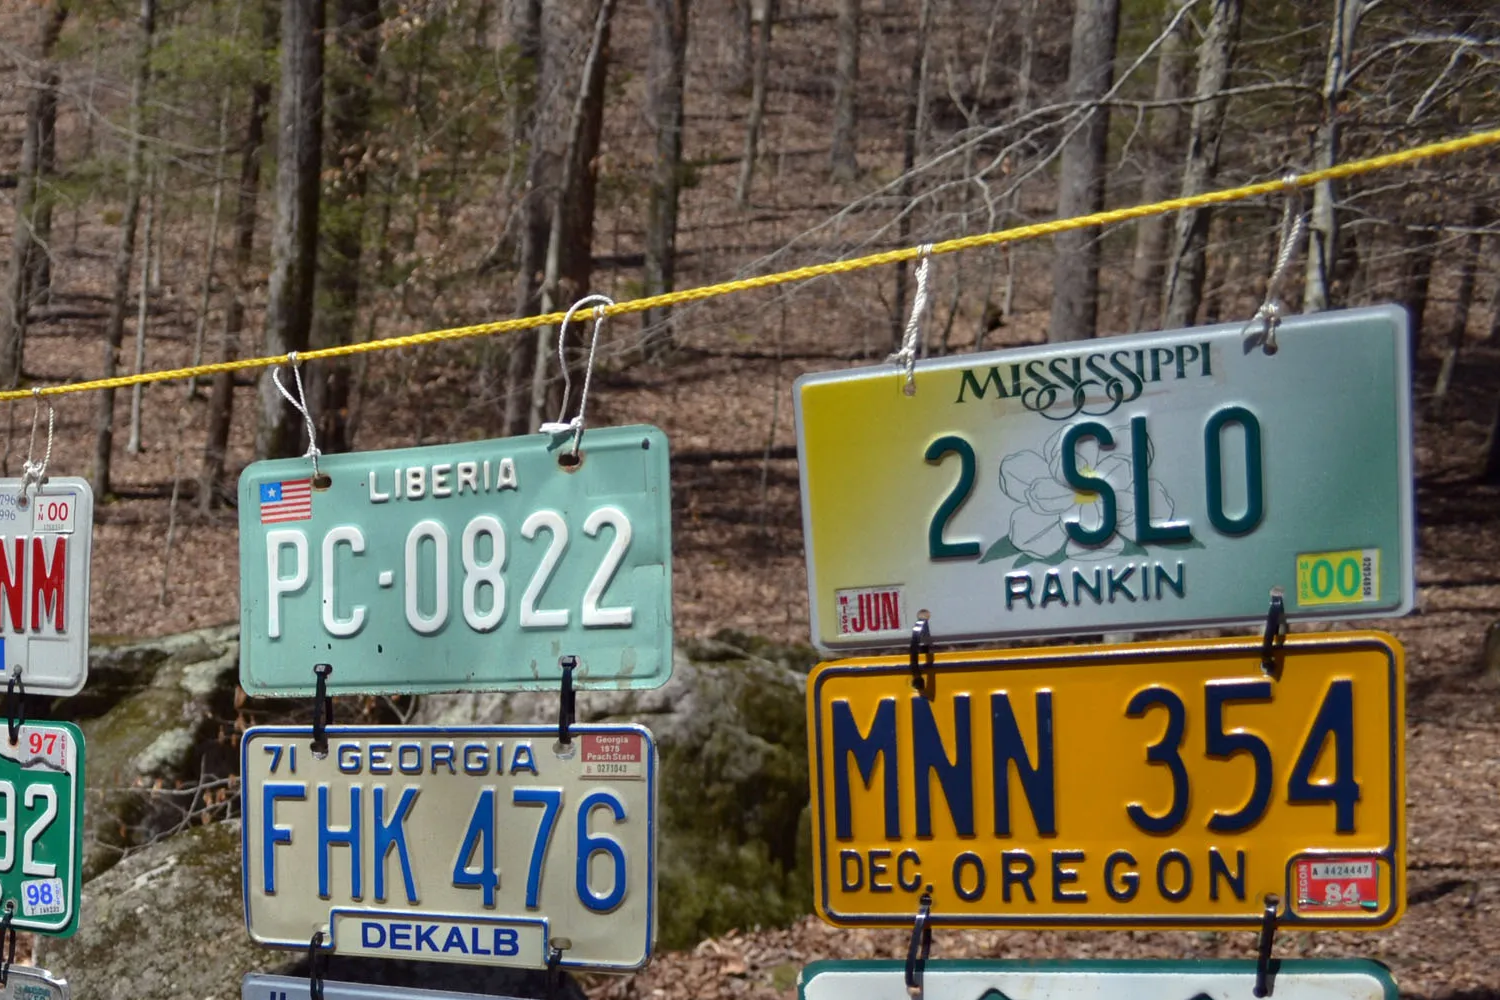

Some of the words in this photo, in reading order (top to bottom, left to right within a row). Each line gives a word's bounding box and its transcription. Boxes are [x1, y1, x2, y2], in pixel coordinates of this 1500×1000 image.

[956, 342, 1212, 420] MISSISSIPPI
[369, 457, 518, 503] LIBERIA
[925, 435, 980, 561] 2
[48, 503, 69, 521] 00
[1005, 563, 1185, 611] RANKIN
[1312, 558, 1361, 599] 00
[853, 592, 899, 633] JUN
[29, 733, 57, 755] 97
[263, 745, 296, 773] 71
[337, 743, 538, 775] GEORGIA
[831, 690, 1056, 840] MNN
[1126, 678, 1360, 837] 354
[263, 784, 420, 904] FHK
[453, 788, 627, 913] 476
[27, 885, 53, 906] 98
[952, 846, 1247, 903] OREGON
[361, 921, 520, 957] DEKALB
